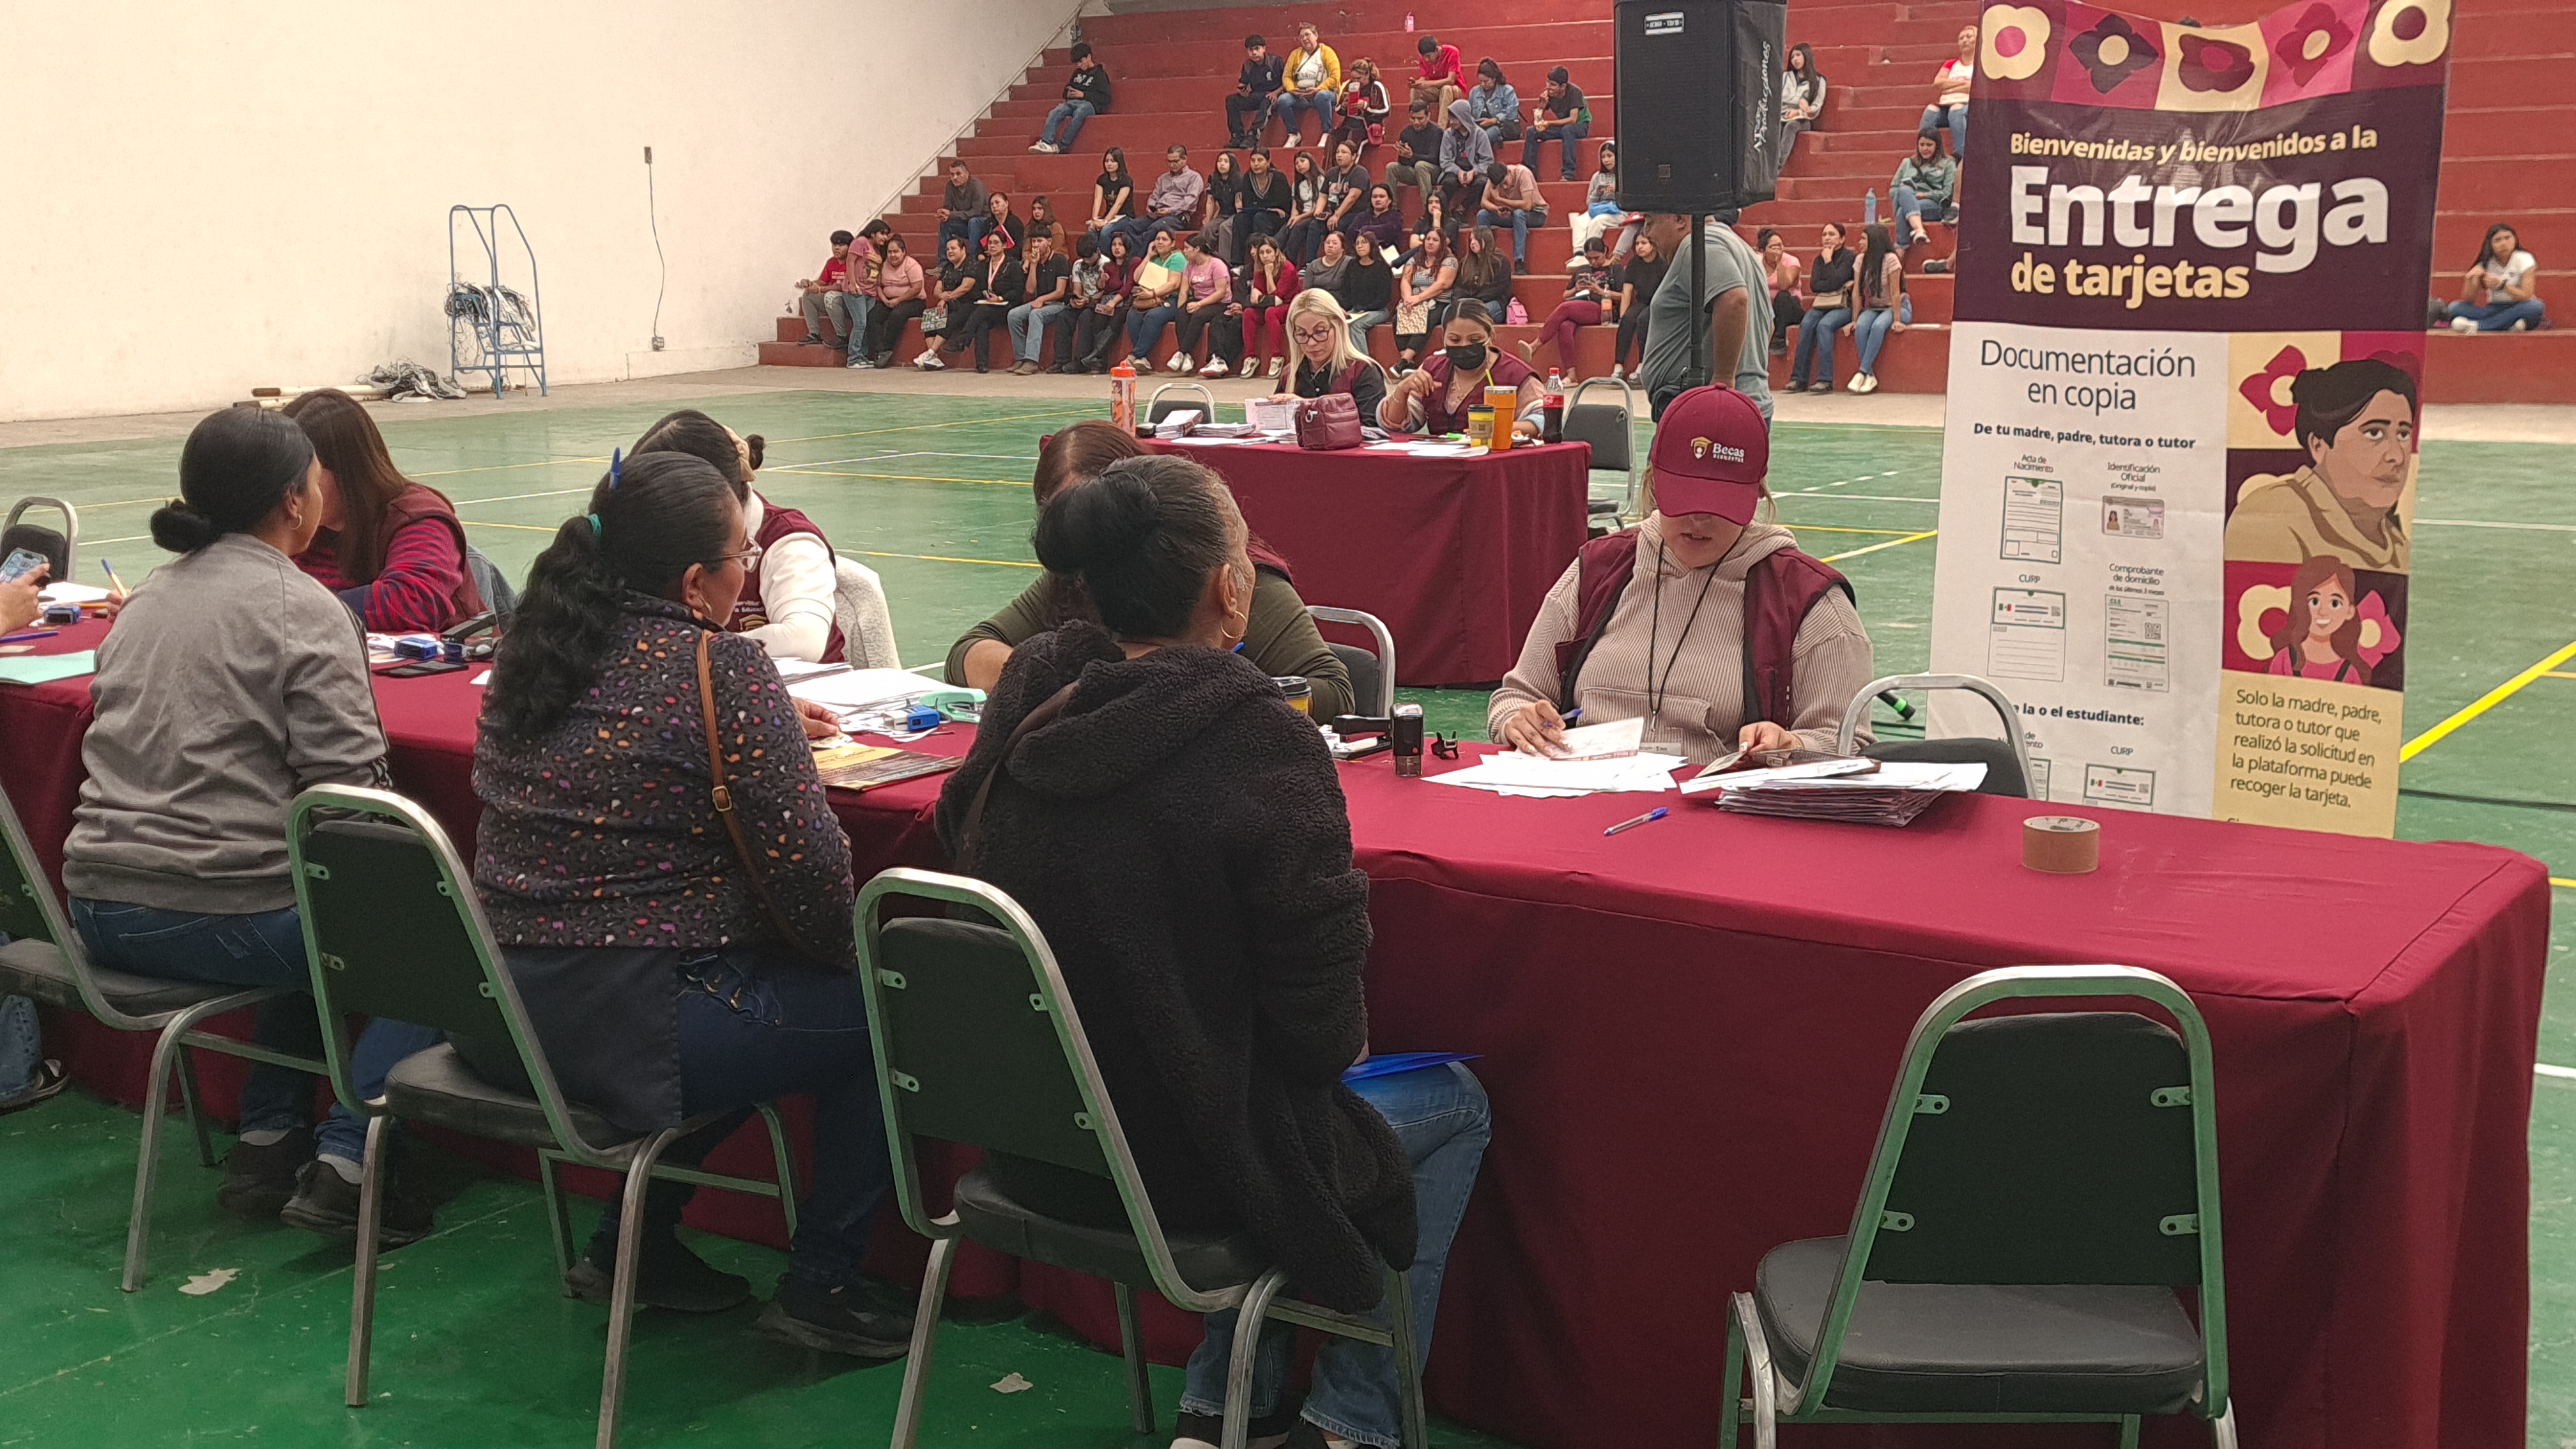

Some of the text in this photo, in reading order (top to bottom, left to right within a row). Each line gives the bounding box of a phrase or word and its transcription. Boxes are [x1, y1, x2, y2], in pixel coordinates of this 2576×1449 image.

[2011, 125, 2378, 165] Bienvenidas y bienvenidos a la
[2011, 165, 2389, 273] Entrega
[2011, 252, 2250, 310] de tarjetas
[1981, 339, 2195, 377] Documentación
[2028, 381, 2136, 416] en copia
[1712, 443, 1745, 457] Becas
[1974, 423, 2196, 448] De tu madre, padre, tutora o tutor
[2037, 456, 2047, 464] de
[2107, 462, 2161, 473] Identificación
[2120, 472, 2146, 482] Oficial
[2109, 564, 2164, 577] Comprobante
[2113, 574, 2123, 582] de
[2023, 703, 2035, 715] la
[2039, 707, 2047, 716] o
[2050, 706, 2063, 717] el
[2066, 709, 2144, 726] estudiante:
[2236, 689, 2382, 724] Solo la madre, padre,
[2235, 712, 2360, 743] tutora o tutor que
[2110, 746, 2134, 756] CURP
[2234, 734, 2375, 767] realizó la solicitud en
[2232, 753, 2372, 790] la plataforma puede
[2230, 777, 2351, 808] recoger la tarjeta.
